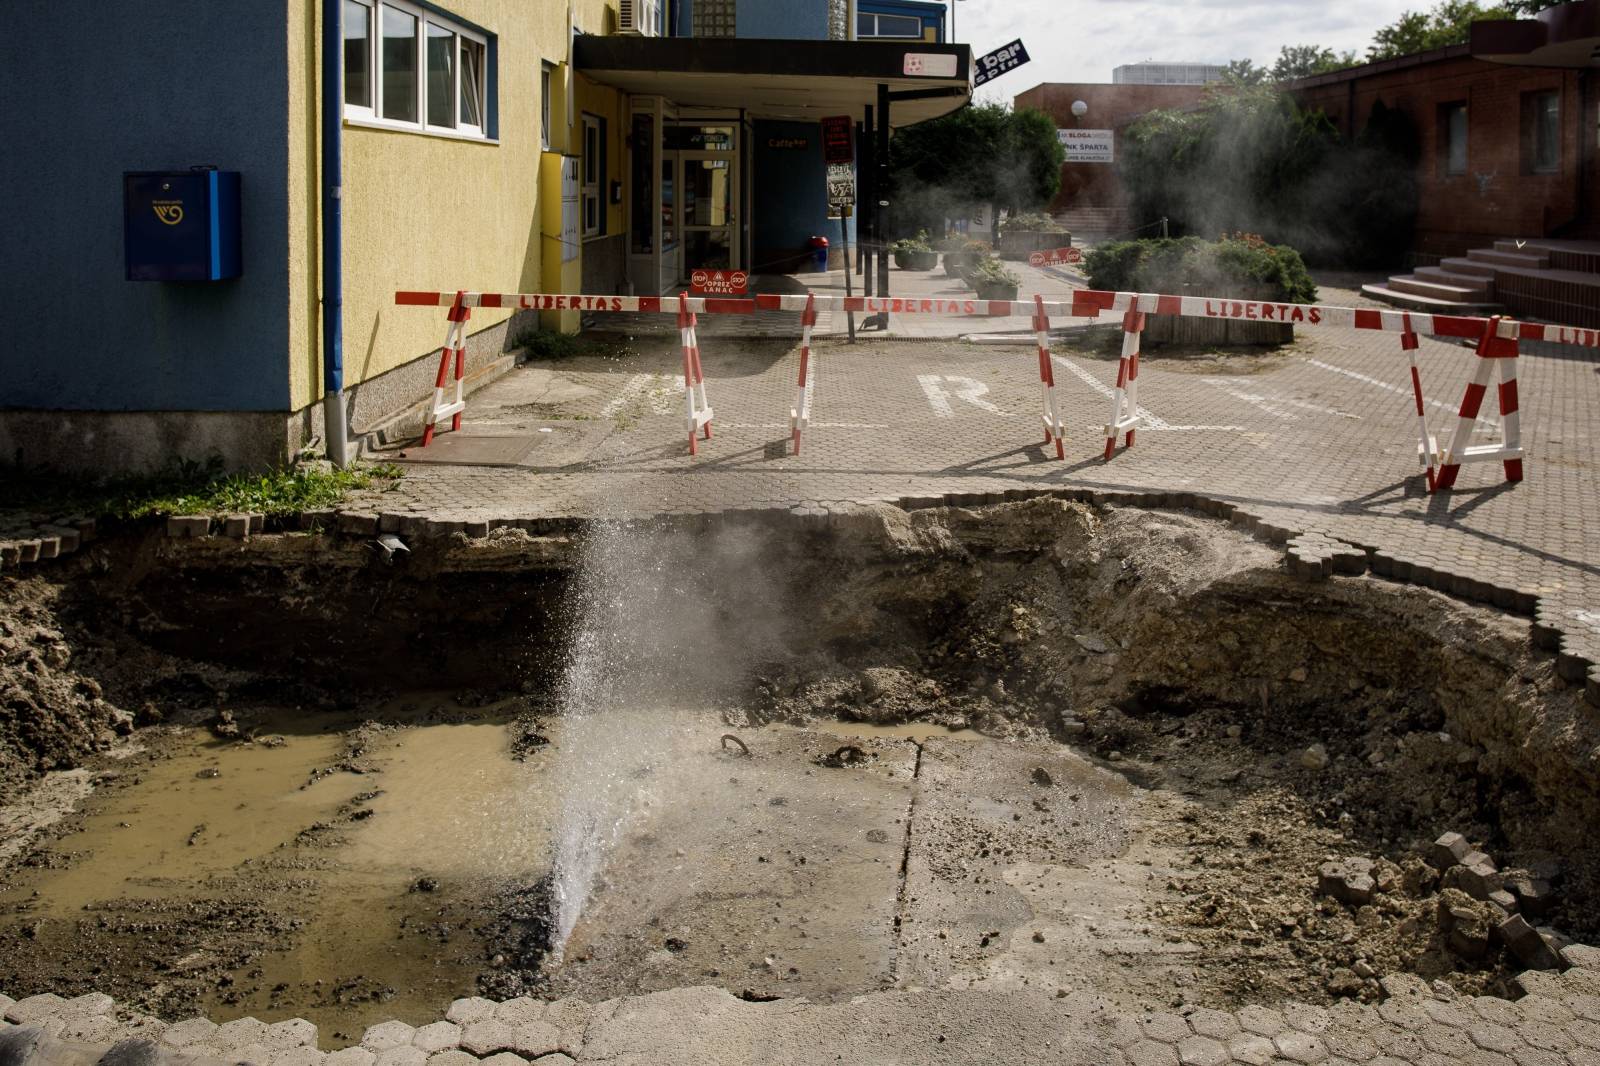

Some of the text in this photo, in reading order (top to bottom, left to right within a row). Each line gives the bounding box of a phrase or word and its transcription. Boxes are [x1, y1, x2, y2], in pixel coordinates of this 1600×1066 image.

[982, 43, 1021, 70] bar
[520, 295, 622, 312] LIBERTAS
[867, 298, 975, 313] LIBERTAS
[1206, 300, 1321, 323] LIBERTAS
[916, 374, 1012, 418] R
